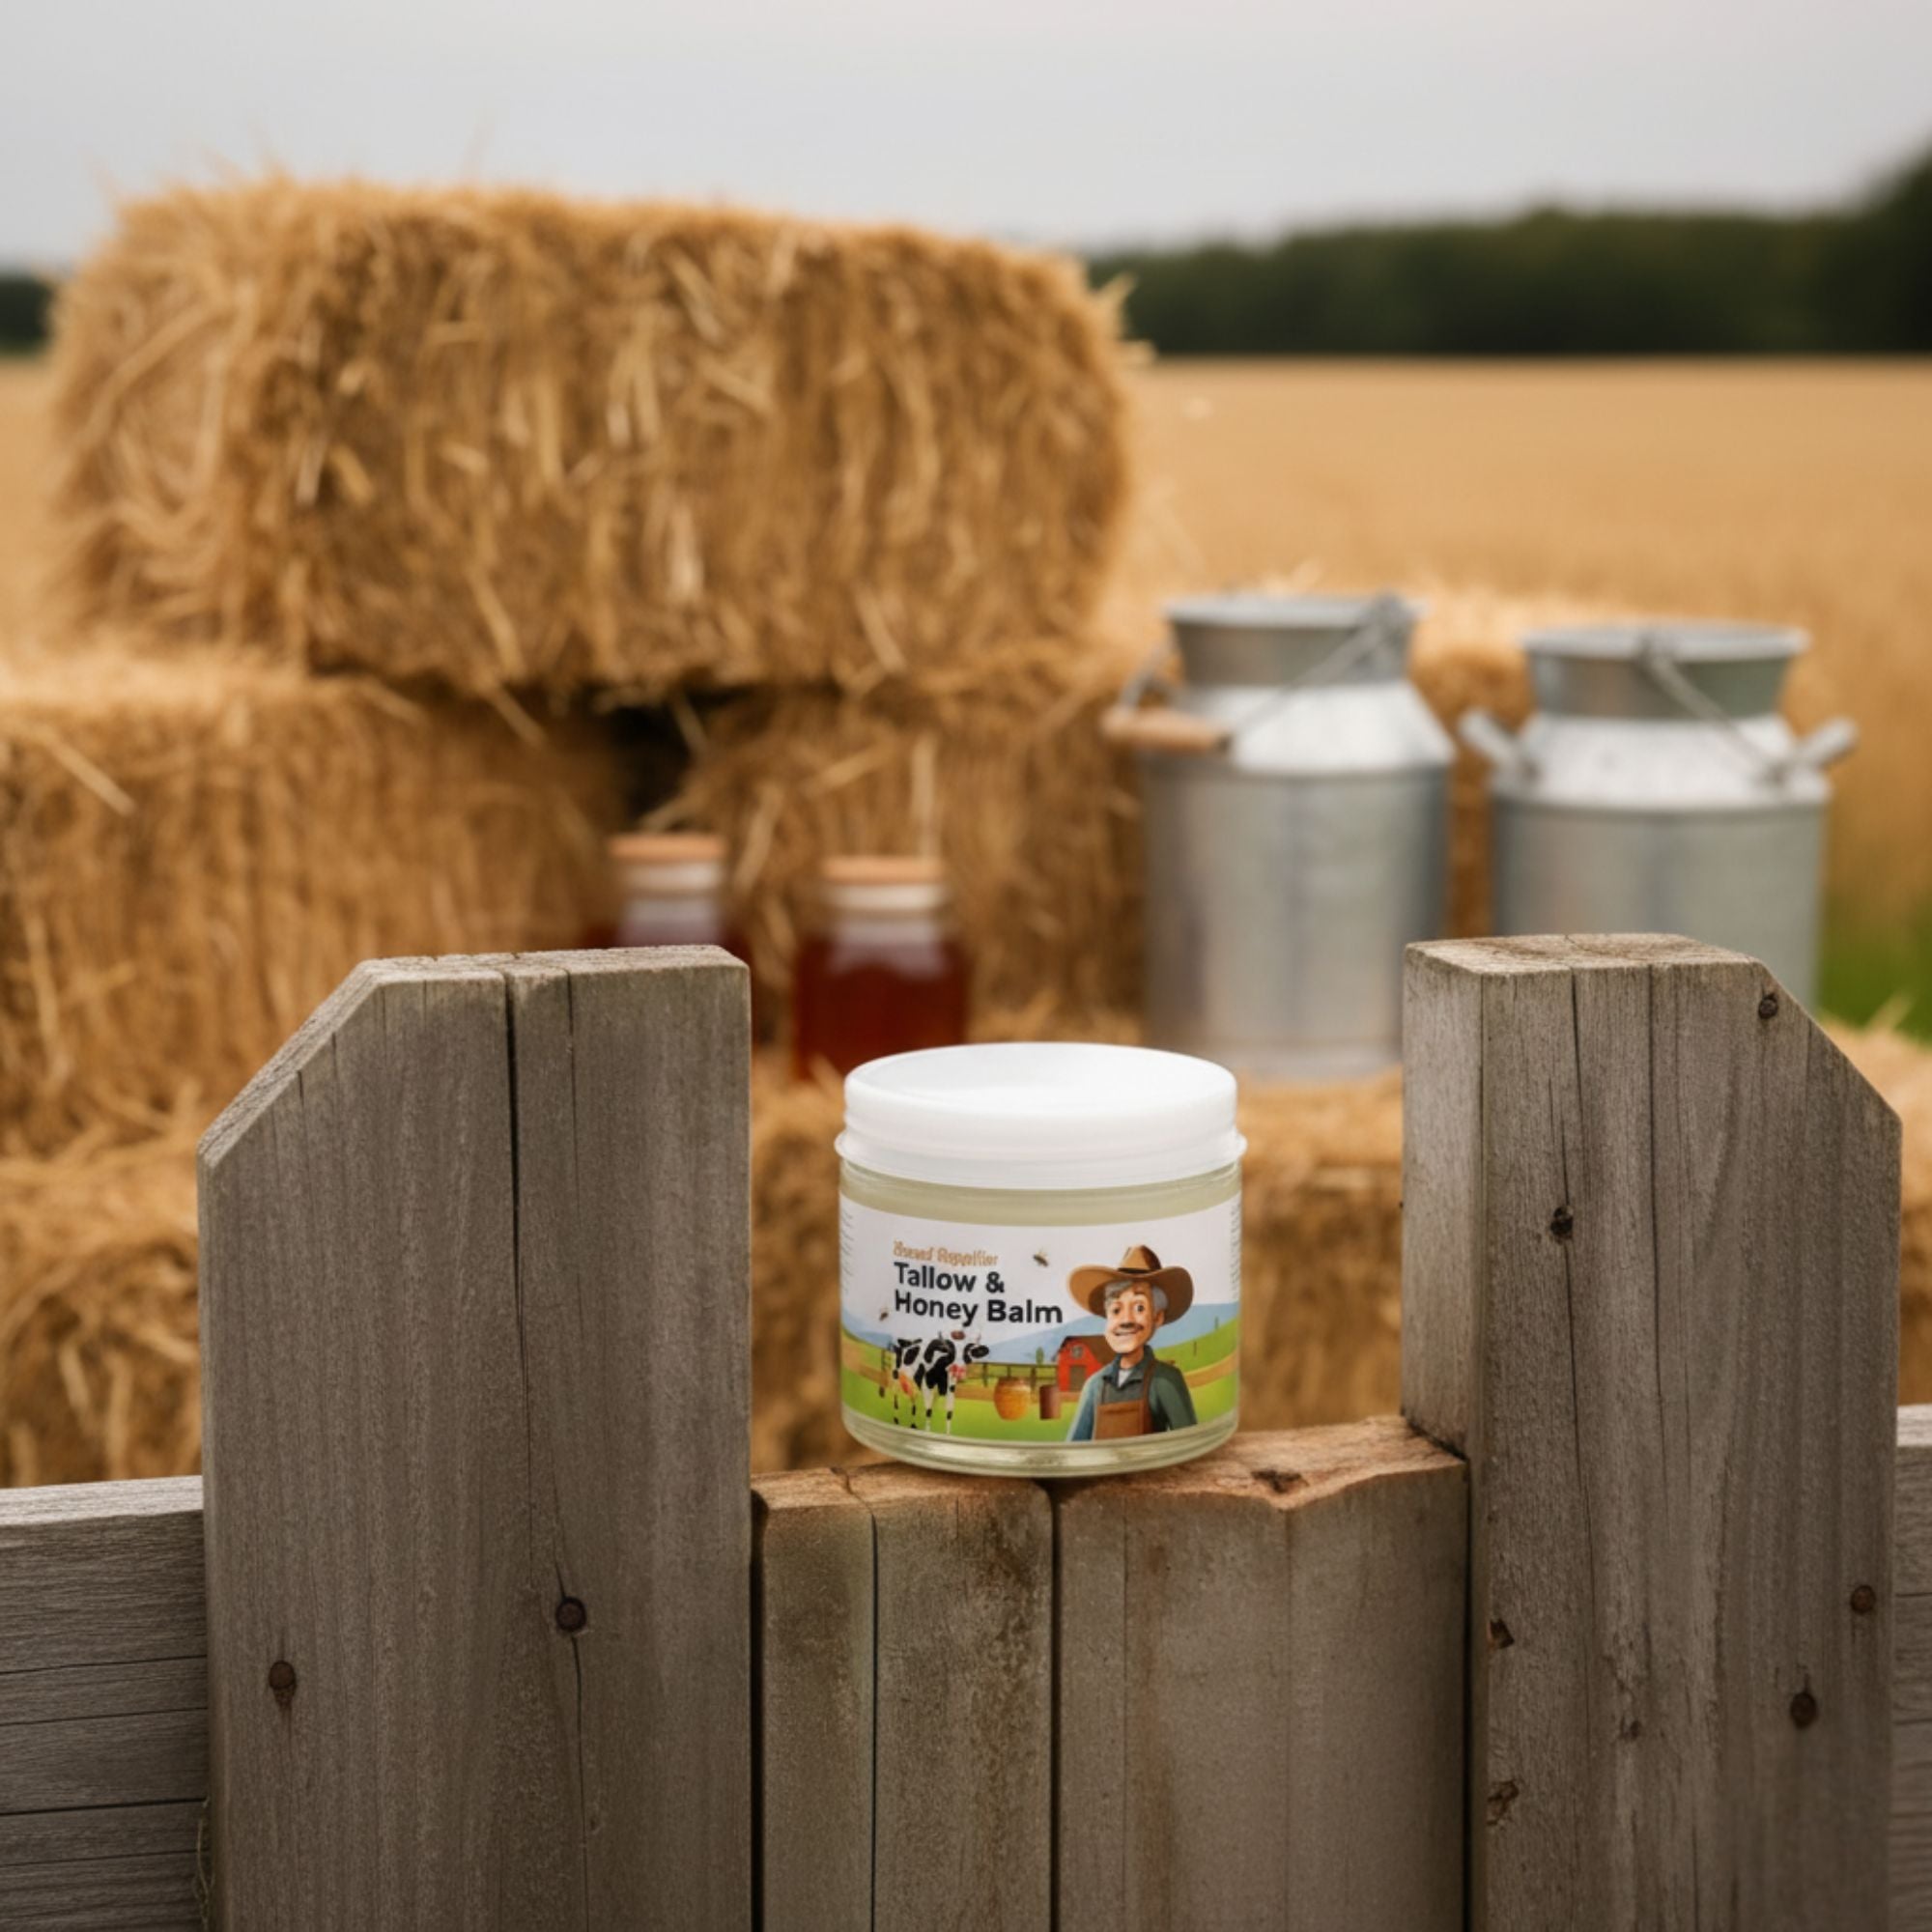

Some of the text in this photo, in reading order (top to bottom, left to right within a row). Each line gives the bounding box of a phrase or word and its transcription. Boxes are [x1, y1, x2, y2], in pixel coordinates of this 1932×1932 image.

[894, 1262, 1005, 1293] Tallow &
[894, 1290, 1063, 1326] Honey Balm
